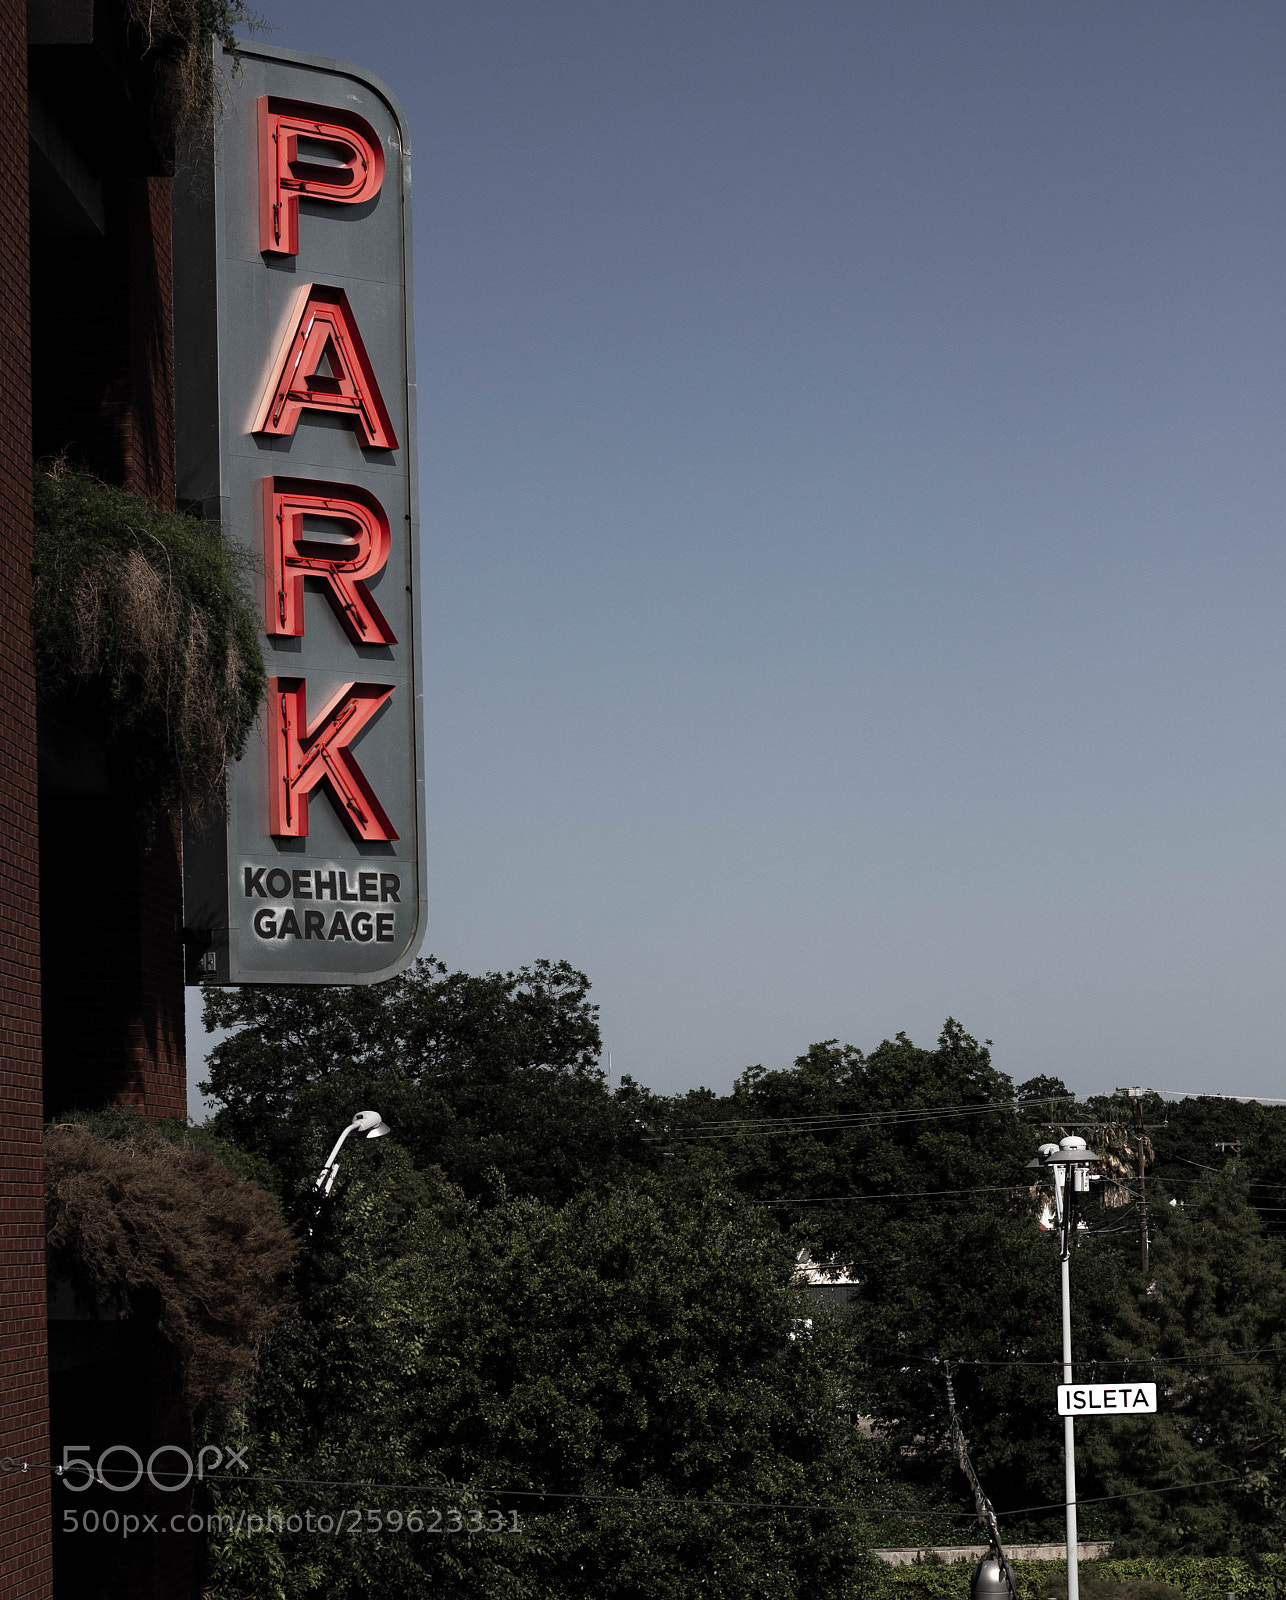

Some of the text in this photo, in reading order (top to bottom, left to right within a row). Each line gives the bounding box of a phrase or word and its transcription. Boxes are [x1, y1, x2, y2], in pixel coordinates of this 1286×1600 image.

[252, 95, 400, 842] PARK
[244, 867, 401, 903] KOEHLER
[254, 908, 395, 942] GARAGE
[1066, 1388, 1149, 1409] ISLETA
